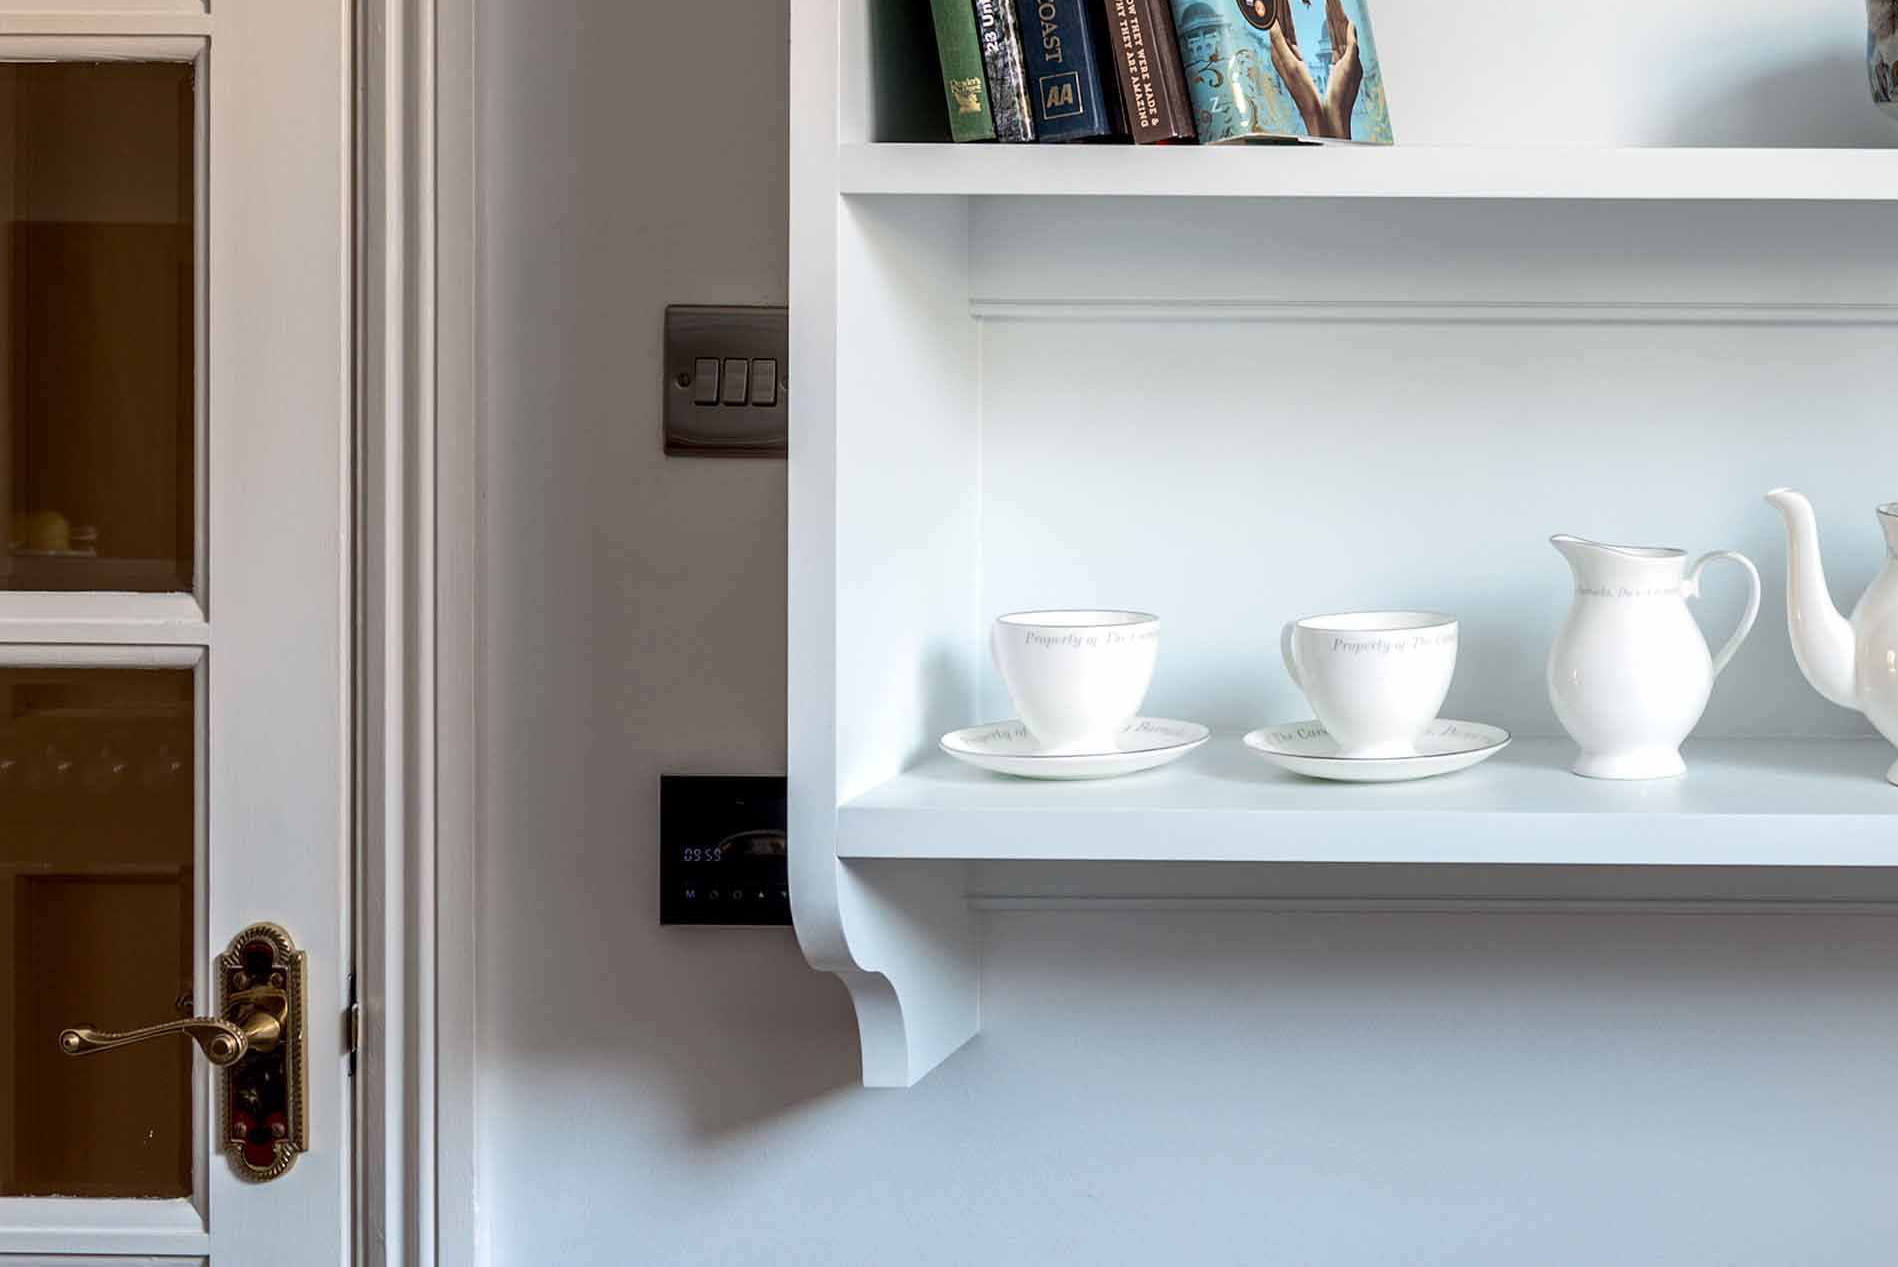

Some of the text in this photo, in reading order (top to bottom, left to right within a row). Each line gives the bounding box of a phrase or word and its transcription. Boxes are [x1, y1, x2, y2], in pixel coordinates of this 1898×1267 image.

[984, 31, 1000, 53] 23
[1119, 17, 1132, 47] THEY
[1129, 17, 1141, 46] THEY
[1125, 49, 1138, 72] ARE
[1134, 47, 1150, 80] WERE
[1046, 83, 1074, 109] AA
[1131, 72, 1149, 128] AMAZING
[1142, 79, 1157, 116] MADE
[1151, 117, 1160, 127] &
[1024, 630, 1083, 648] Property
[1330, 636, 1391, 654] Property
